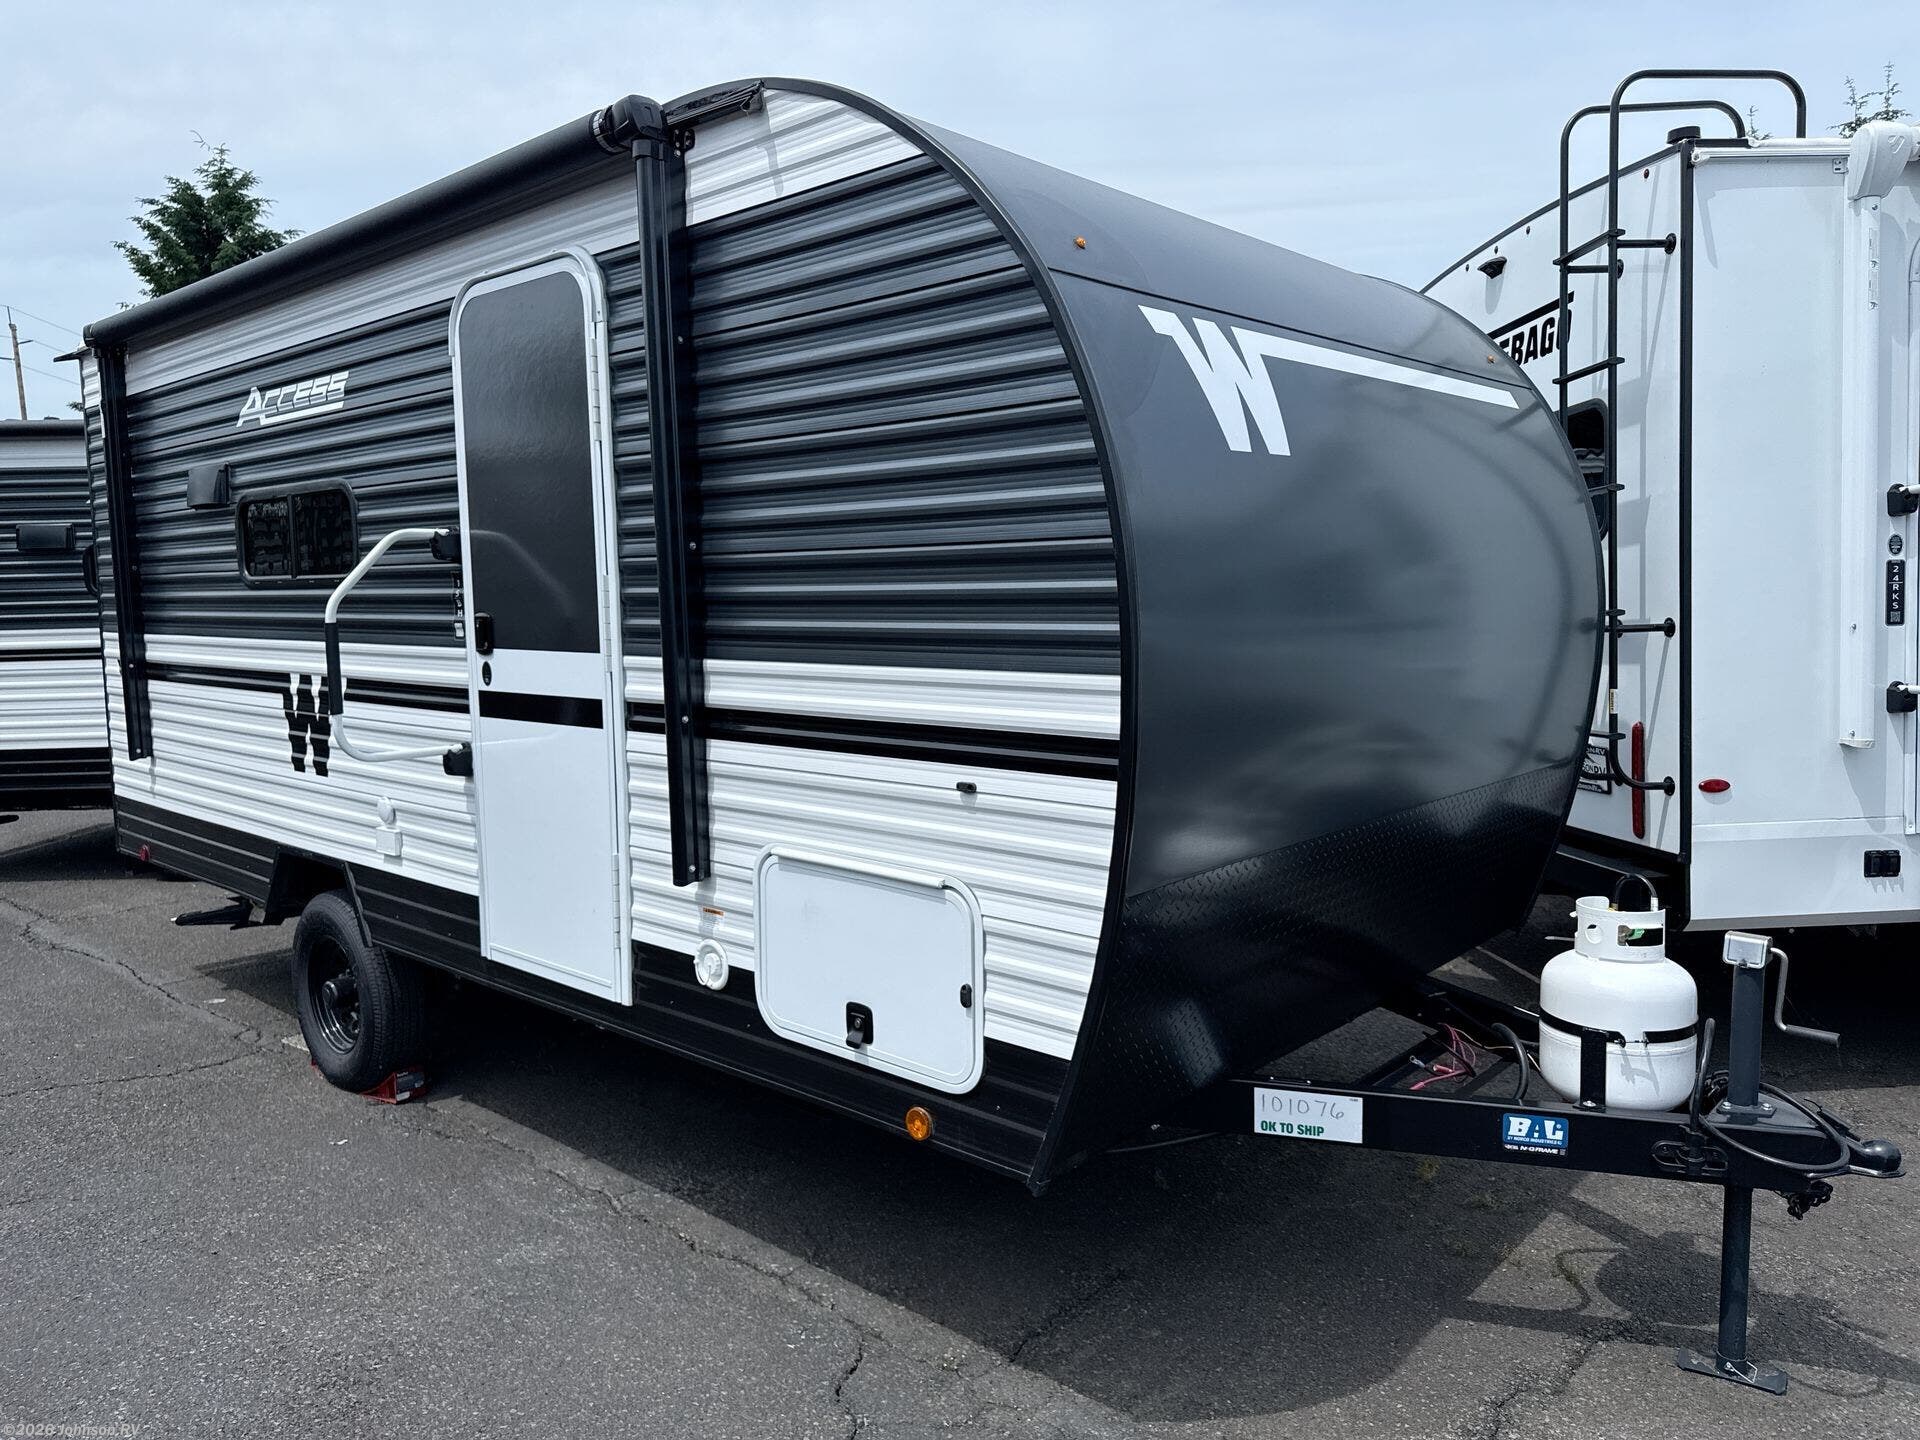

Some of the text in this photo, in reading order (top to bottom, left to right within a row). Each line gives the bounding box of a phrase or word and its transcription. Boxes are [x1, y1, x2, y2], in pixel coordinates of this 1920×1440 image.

[1262, 1094, 1344, 1119] 101076
[1261, 1120, 1325, 1137] OK TO SHIP
